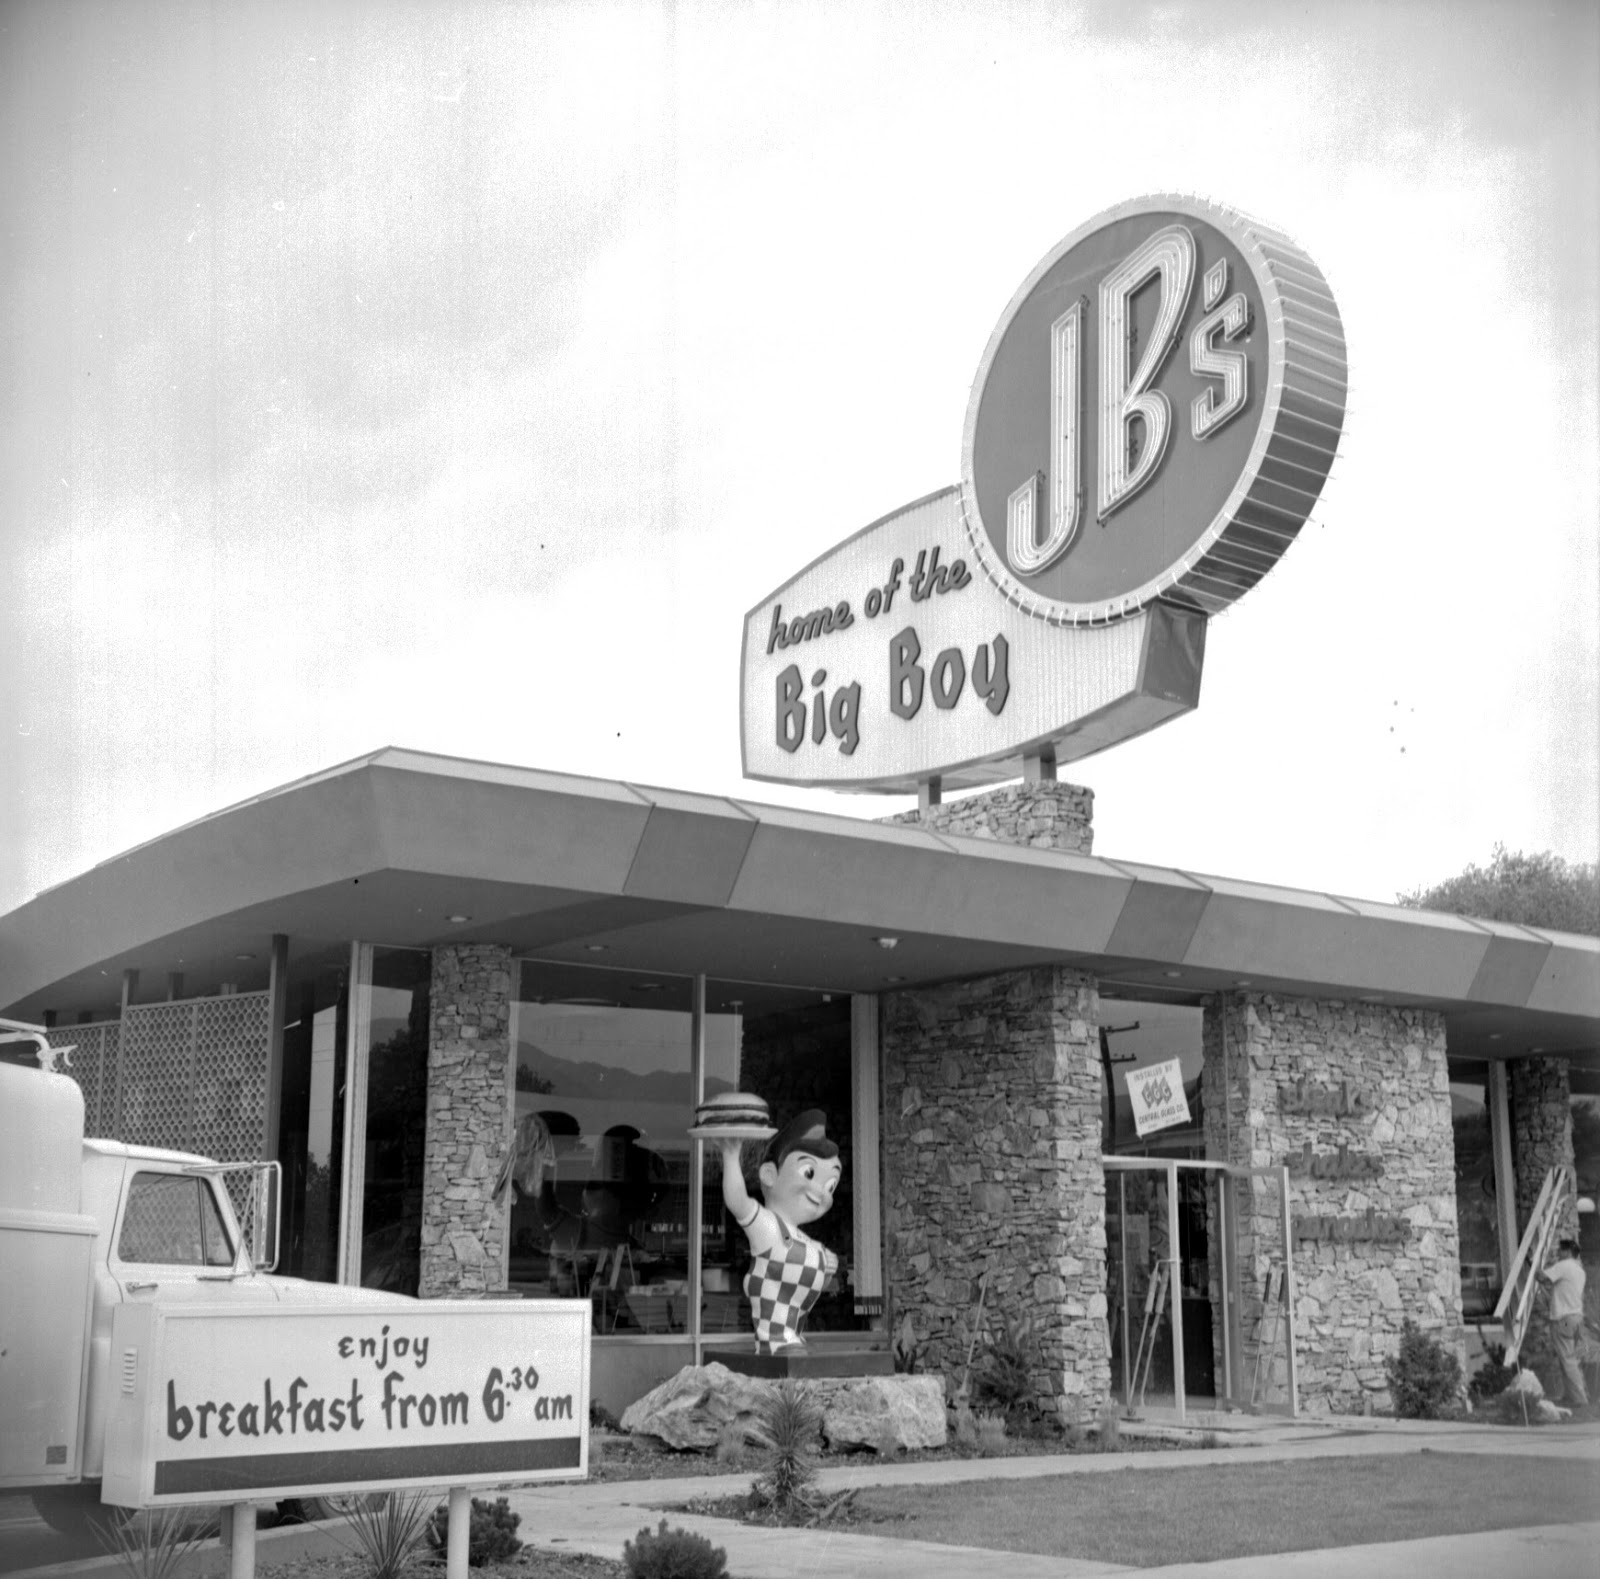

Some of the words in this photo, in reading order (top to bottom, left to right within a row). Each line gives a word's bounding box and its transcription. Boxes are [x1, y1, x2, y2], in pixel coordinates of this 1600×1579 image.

[1007, 223, 1247, 576] JB's
[766, 604, 855, 655] home
[864, 558, 904, 618] of
[909, 545, 972, 602] the
[776, 664, 861, 756] Big
[890, 626, 1010, 720] Boy
[338, 1325, 429, 1369] enjoy
[166, 1376, 364, 1441] breakfast
[382, 1370, 468, 1430] from
[534, 1392, 573, 1421] am
